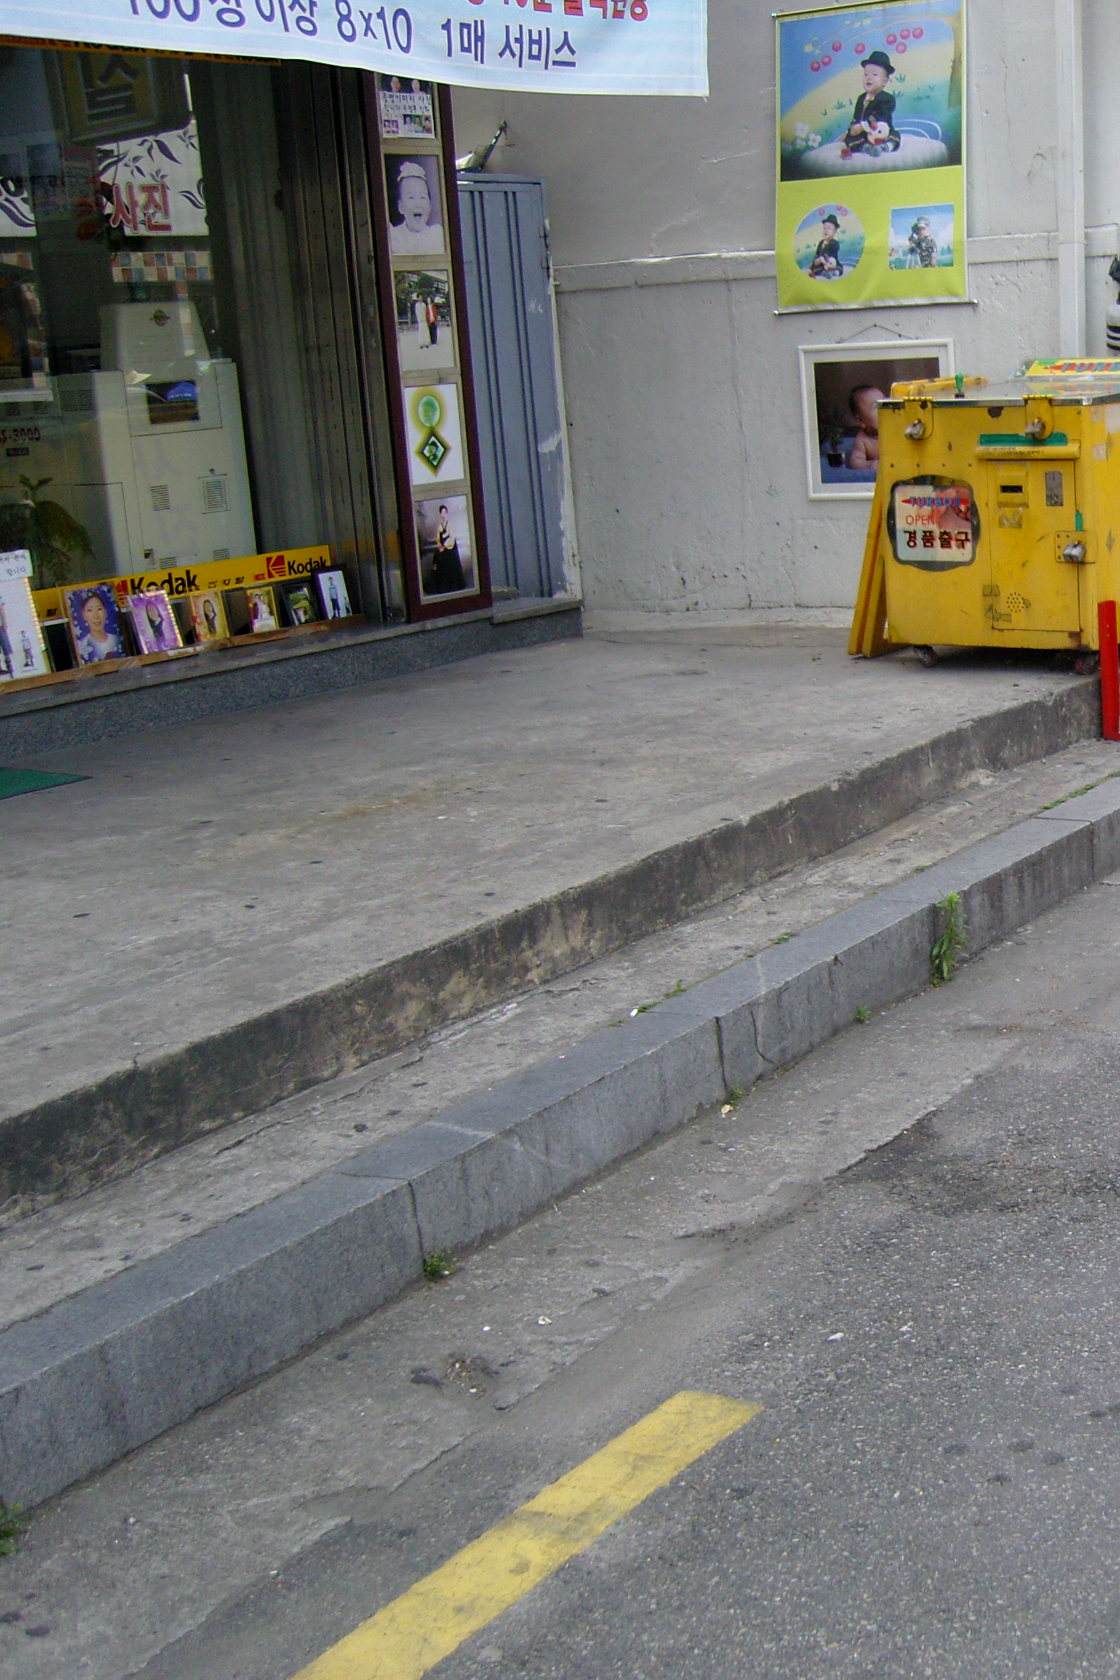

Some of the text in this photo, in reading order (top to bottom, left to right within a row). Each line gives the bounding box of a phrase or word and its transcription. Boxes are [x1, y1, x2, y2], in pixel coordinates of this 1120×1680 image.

[441, 18, 485, 64] 1매
[498, 24, 577, 70] 서비스
[109, 181, 173, 233] 사진
[905, 515, 936, 526] OPEN
[903, 530, 971, 550] 경품출구
[286, 555, 328, 576] Kodak
